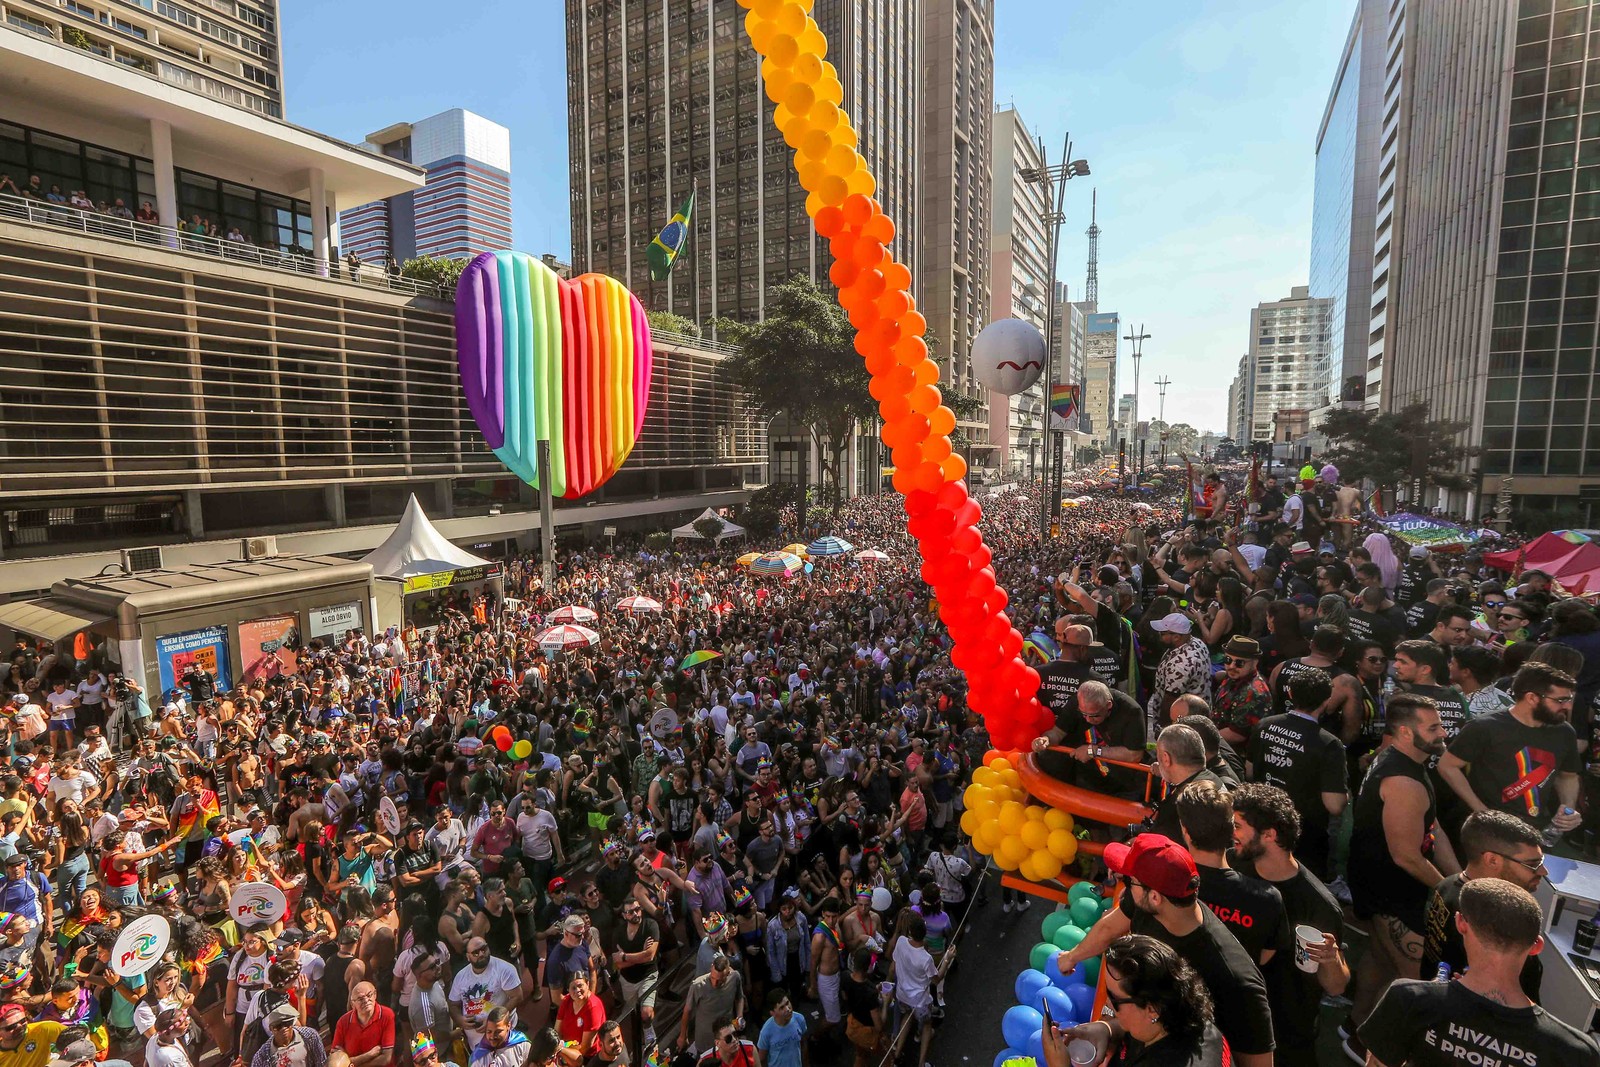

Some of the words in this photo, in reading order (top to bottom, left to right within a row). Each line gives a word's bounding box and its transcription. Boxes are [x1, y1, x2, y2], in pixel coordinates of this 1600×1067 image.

[1411, 478, 1421, 506] Augusta
[321, 614, 336, 624] ALGO
[161, 636, 178, 646] QUEM
[164, 643, 185, 653] ENSINA
[185, 640, 201, 649] COMO
[1041, 681, 1046, 690] É
[1047, 683, 1079, 693] PROBLEM
[1048, 675, 1080, 685] HIV/AIDS
[1436, 701, 1462, 709] IV/AIDS
[1268, 724, 1303, 740] HIV/AIDS
[1260, 729, 1265, 739] É
[1264, 732, 1305, 753] PROBLEMA
[238, 899, 274, 917] Pride
[121, 935, 158, 968] Pride
[1425, 1029, 1437, 1047] É
[1448, 1022, 1538, 1067] HIV/AIDS
